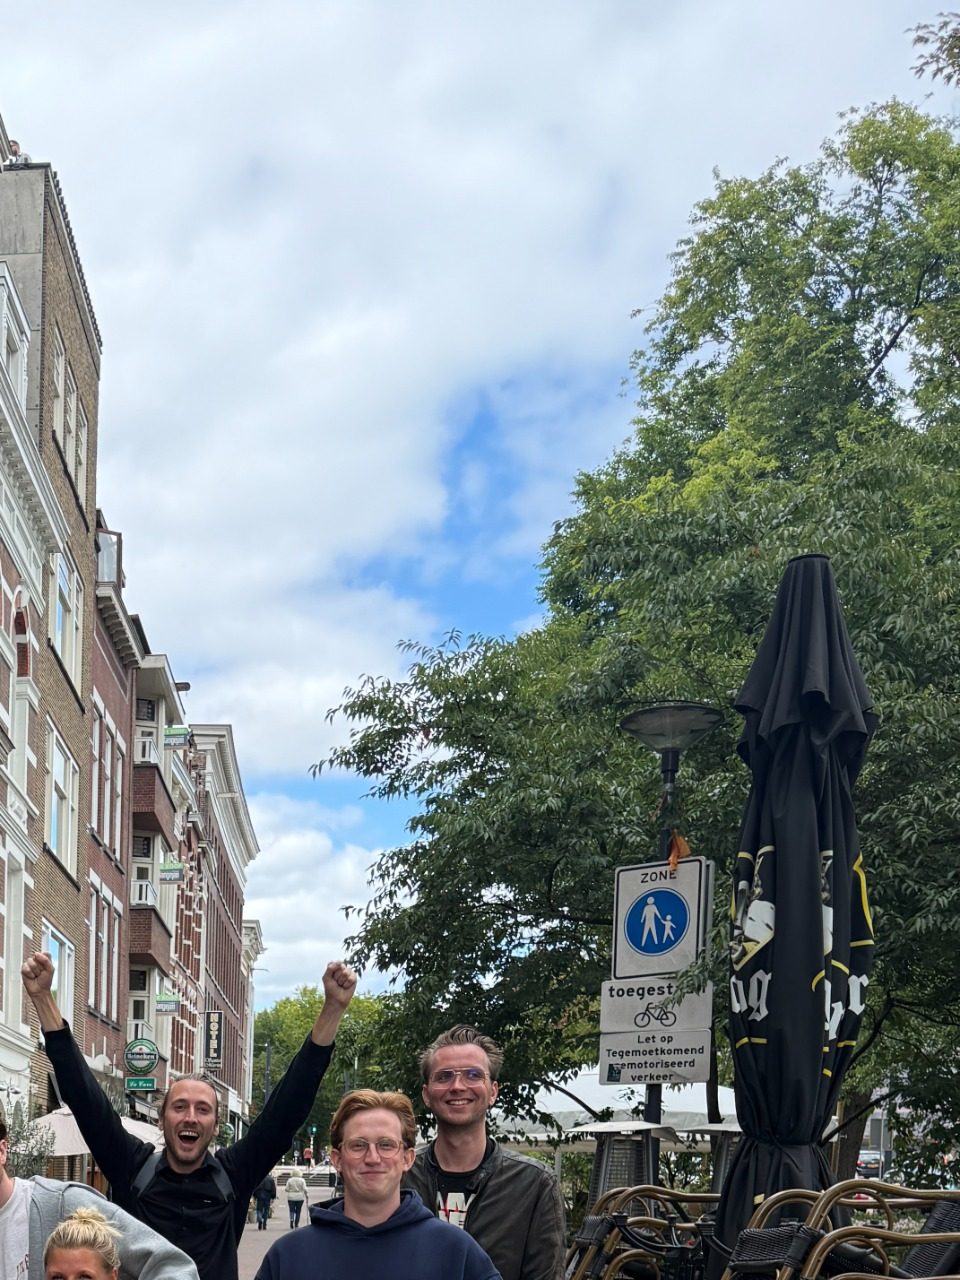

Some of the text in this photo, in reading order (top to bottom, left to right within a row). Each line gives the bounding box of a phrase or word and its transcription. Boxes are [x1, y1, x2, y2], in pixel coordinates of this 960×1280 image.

[640, 869, 678, 884] ZONE
[608, 983, 706, 1001] toegest
[637, 1034, 674, 1045] Let op
[605, 1045, 705, 1059] Tegemoetkomend
[630, 1072, 675, 1082] verkeer
